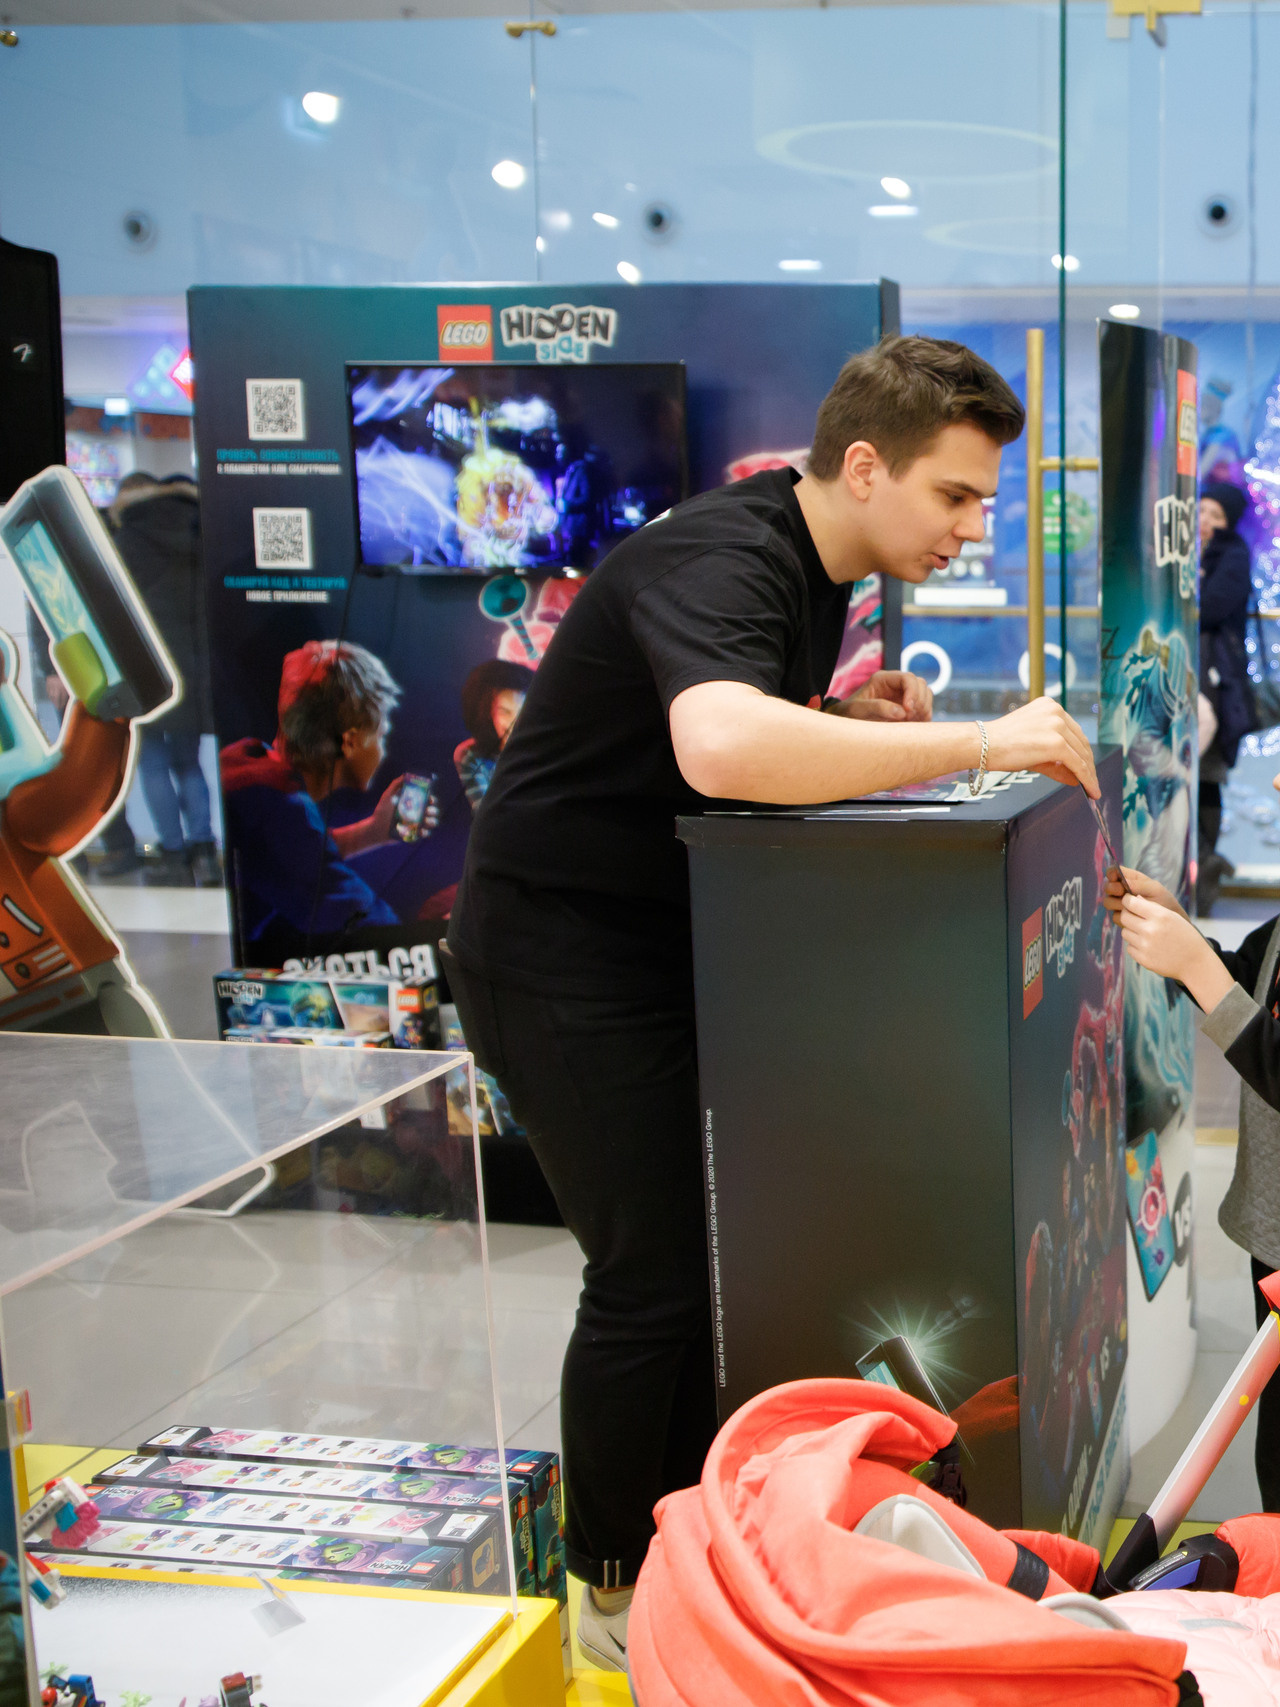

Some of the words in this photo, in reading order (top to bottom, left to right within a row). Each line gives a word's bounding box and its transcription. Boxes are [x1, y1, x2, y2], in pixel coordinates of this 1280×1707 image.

[441, 321, 491, 348] LEGO
[502, 305, 615, 345] HIDDEN
[538, 334, 587, 361] SIDE
[1024, 937, 1042, 987] LEGO
[1046, 879, 1081, 961] HIDDEN
[705, 1108, 713, 1131] Group.
[706, 1131, 714, 1152] LEGO
[710, 1214, 718, 1235] LEGO
[716, 1306, 724, 1321] logo
[716, 1322, 724, 1341] LEGO
